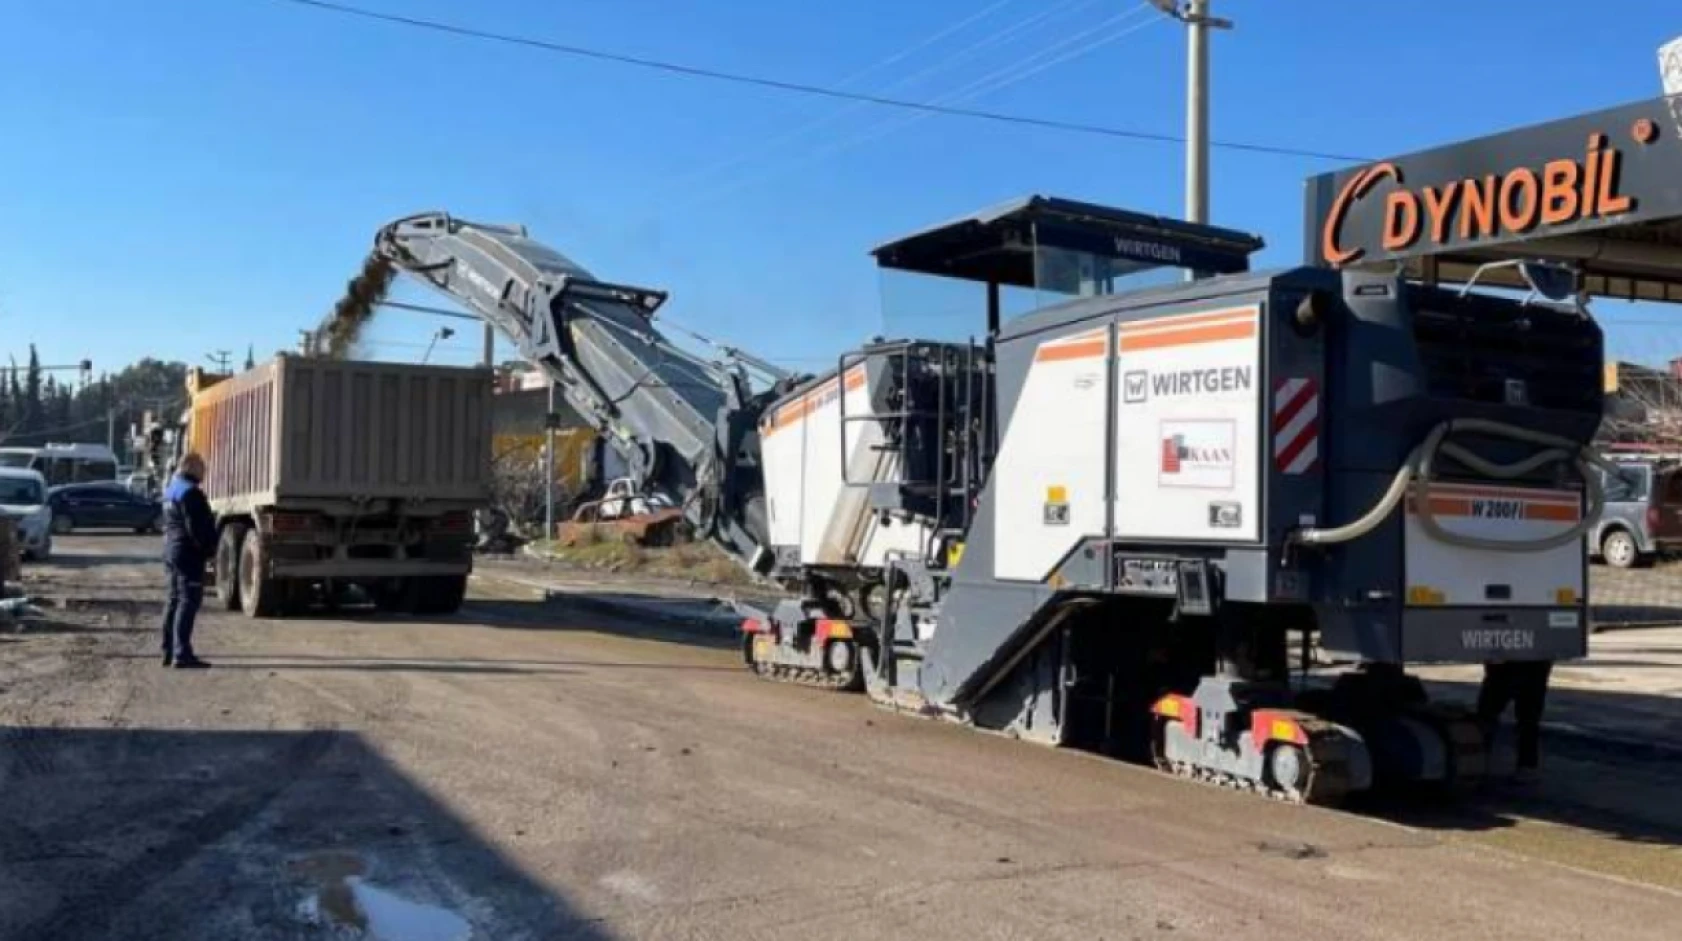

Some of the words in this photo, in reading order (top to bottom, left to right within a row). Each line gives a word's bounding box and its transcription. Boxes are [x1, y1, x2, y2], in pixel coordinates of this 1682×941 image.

[1382, 133, 1632, 249] DYNOBİL
[1114, 235, 1180, 262] WIRTGEN
[1152, 365, 1250, 396] WIRTGEN
[1462, 629, 1534, 649] WIRTGEN
